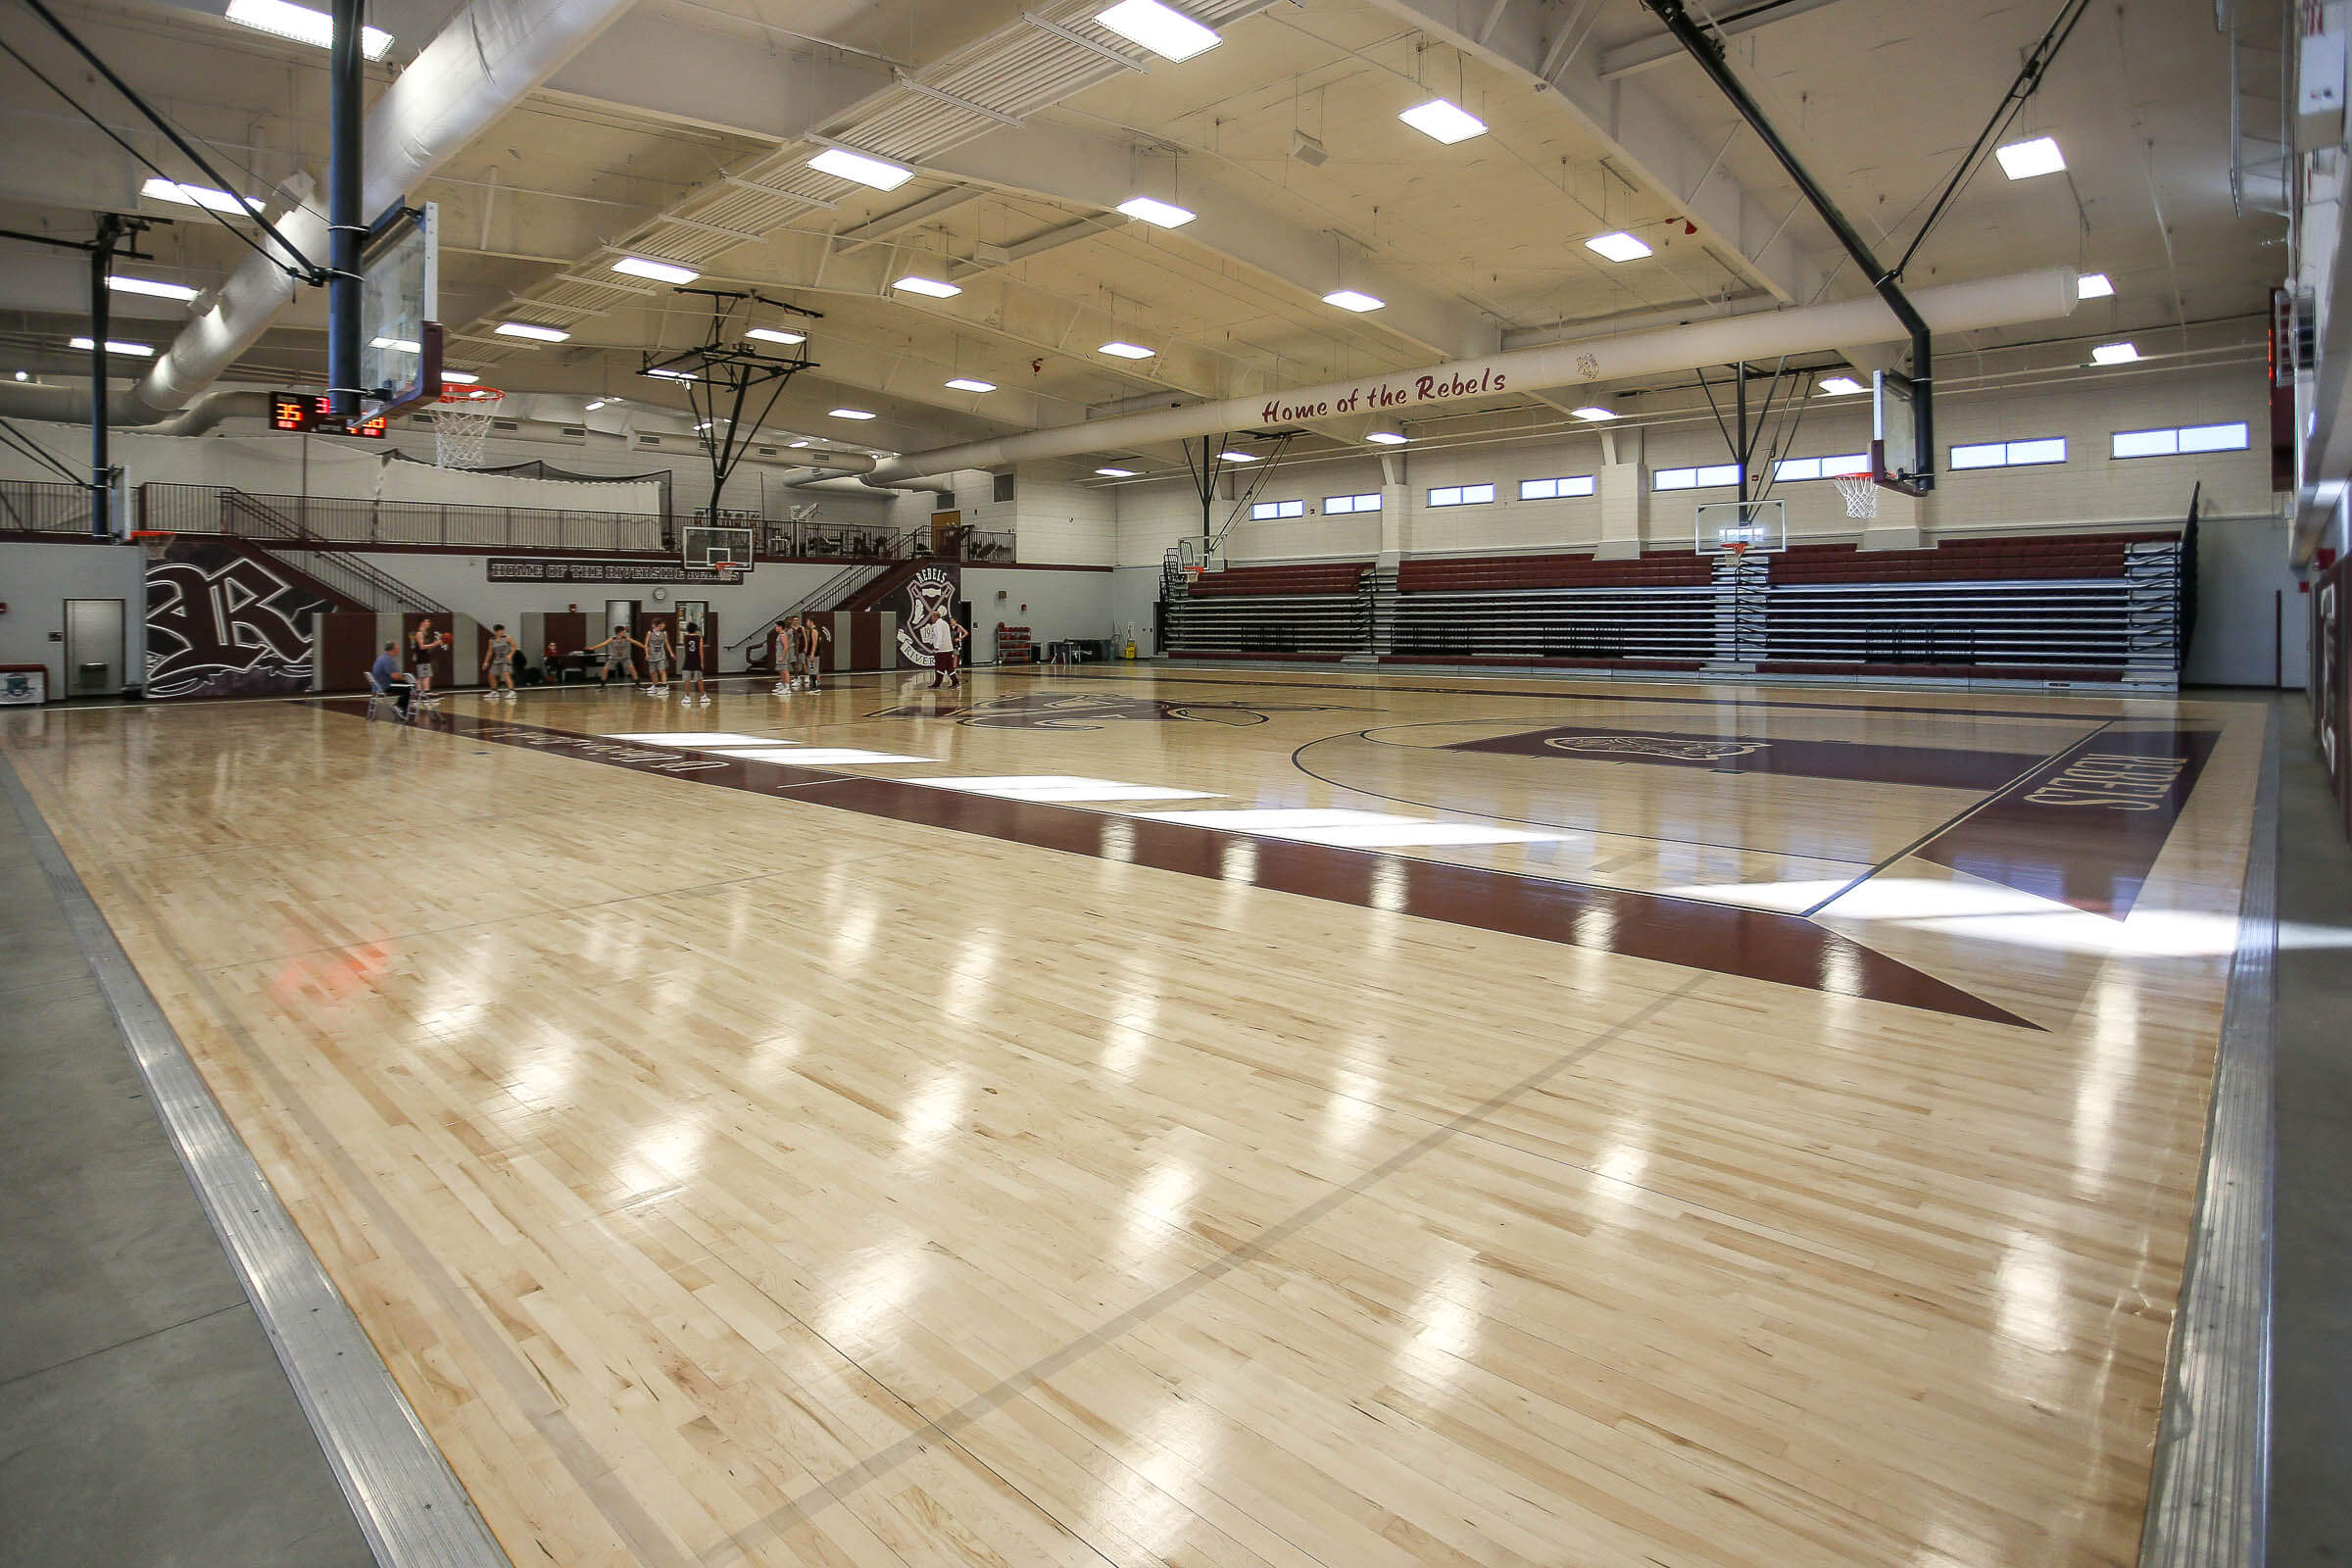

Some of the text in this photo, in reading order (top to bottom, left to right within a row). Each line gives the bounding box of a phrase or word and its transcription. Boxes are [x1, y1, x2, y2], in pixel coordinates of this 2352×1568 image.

[1261, 368, 1506, 423] Home of the Rebels
[276, 403, 303, 421] 35
[492, 564, 740, 581] HOME OF THE RIVERSIDE REBS
[915, 567, 948, 584] REBELS
